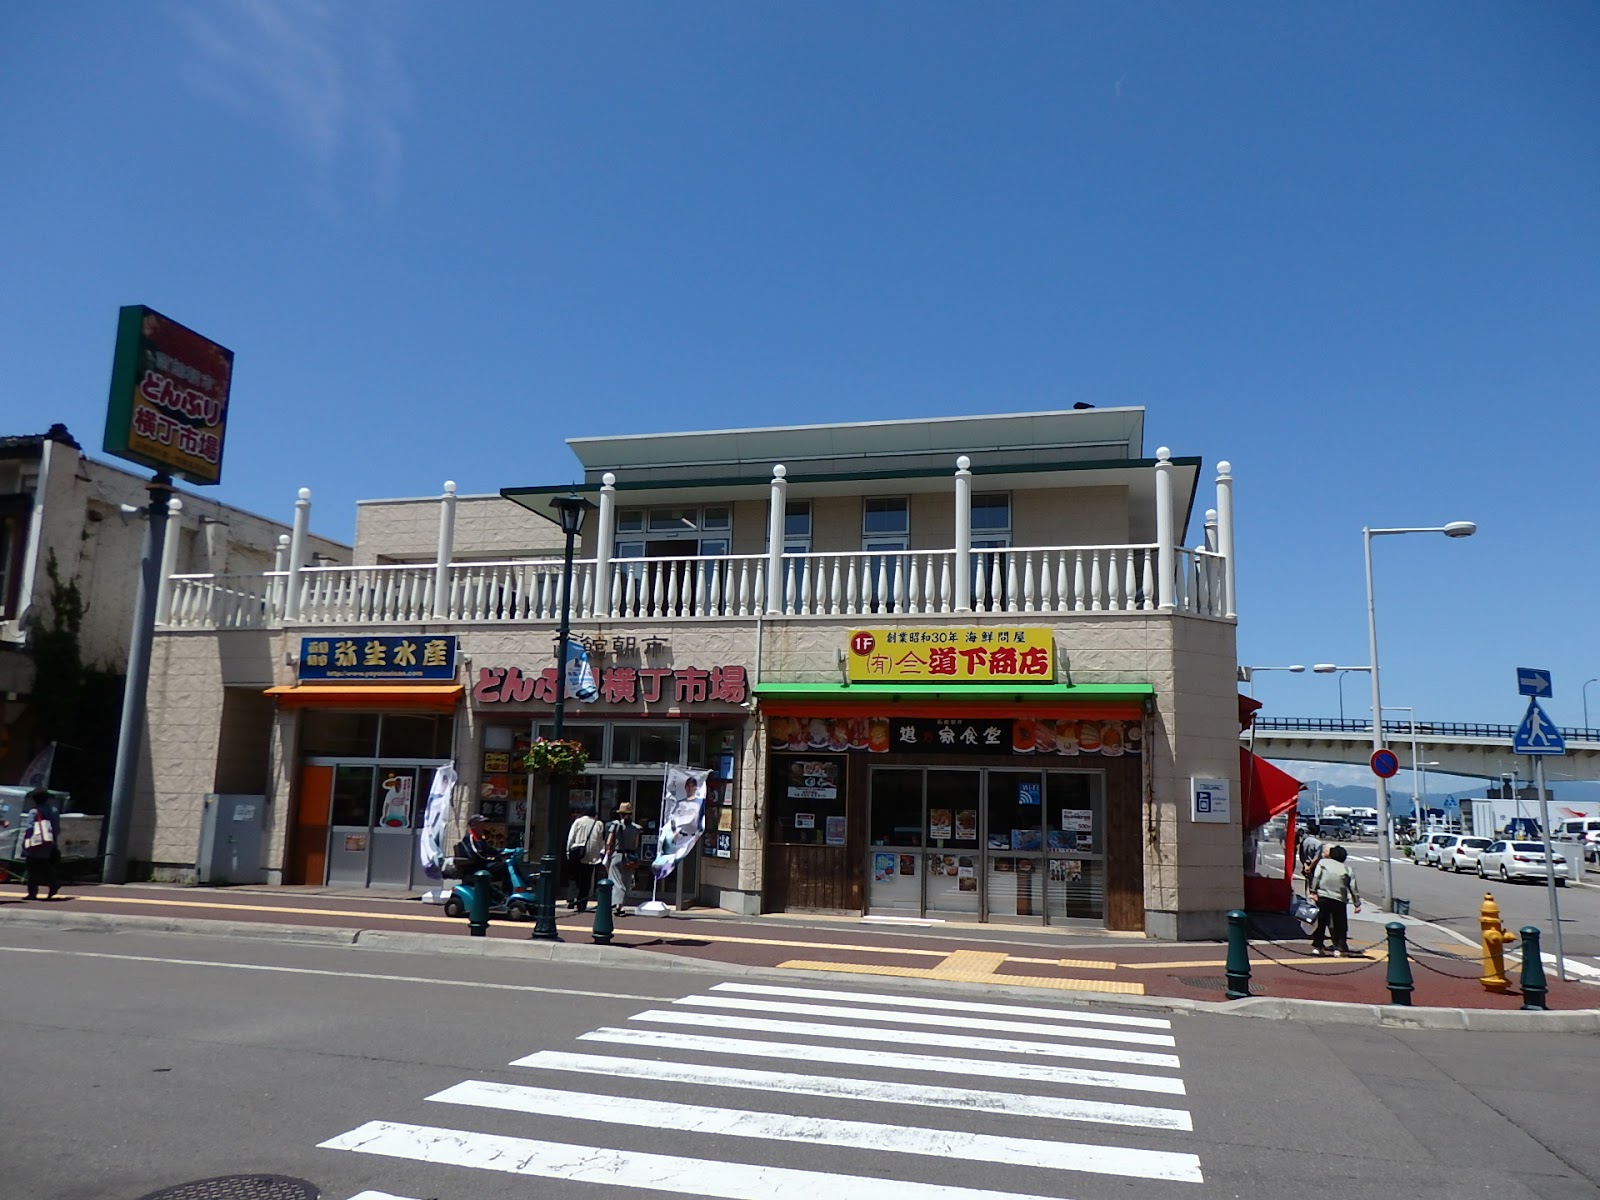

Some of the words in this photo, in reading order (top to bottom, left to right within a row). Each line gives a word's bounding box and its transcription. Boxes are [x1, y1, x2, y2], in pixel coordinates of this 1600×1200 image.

[140, 370, 221, 426] どんぶり
[133, 406, 219, 463] 横丁市場
[334, 639, 447, 666] 弥生水産
[855, 637, 874, 650] 1F
[886, 631, 958, 643] 創業昭和30年
[965, 631, 1026, 643] 海鮮問屋
[473, 666, 747, 704] どんぶ横丁市場
